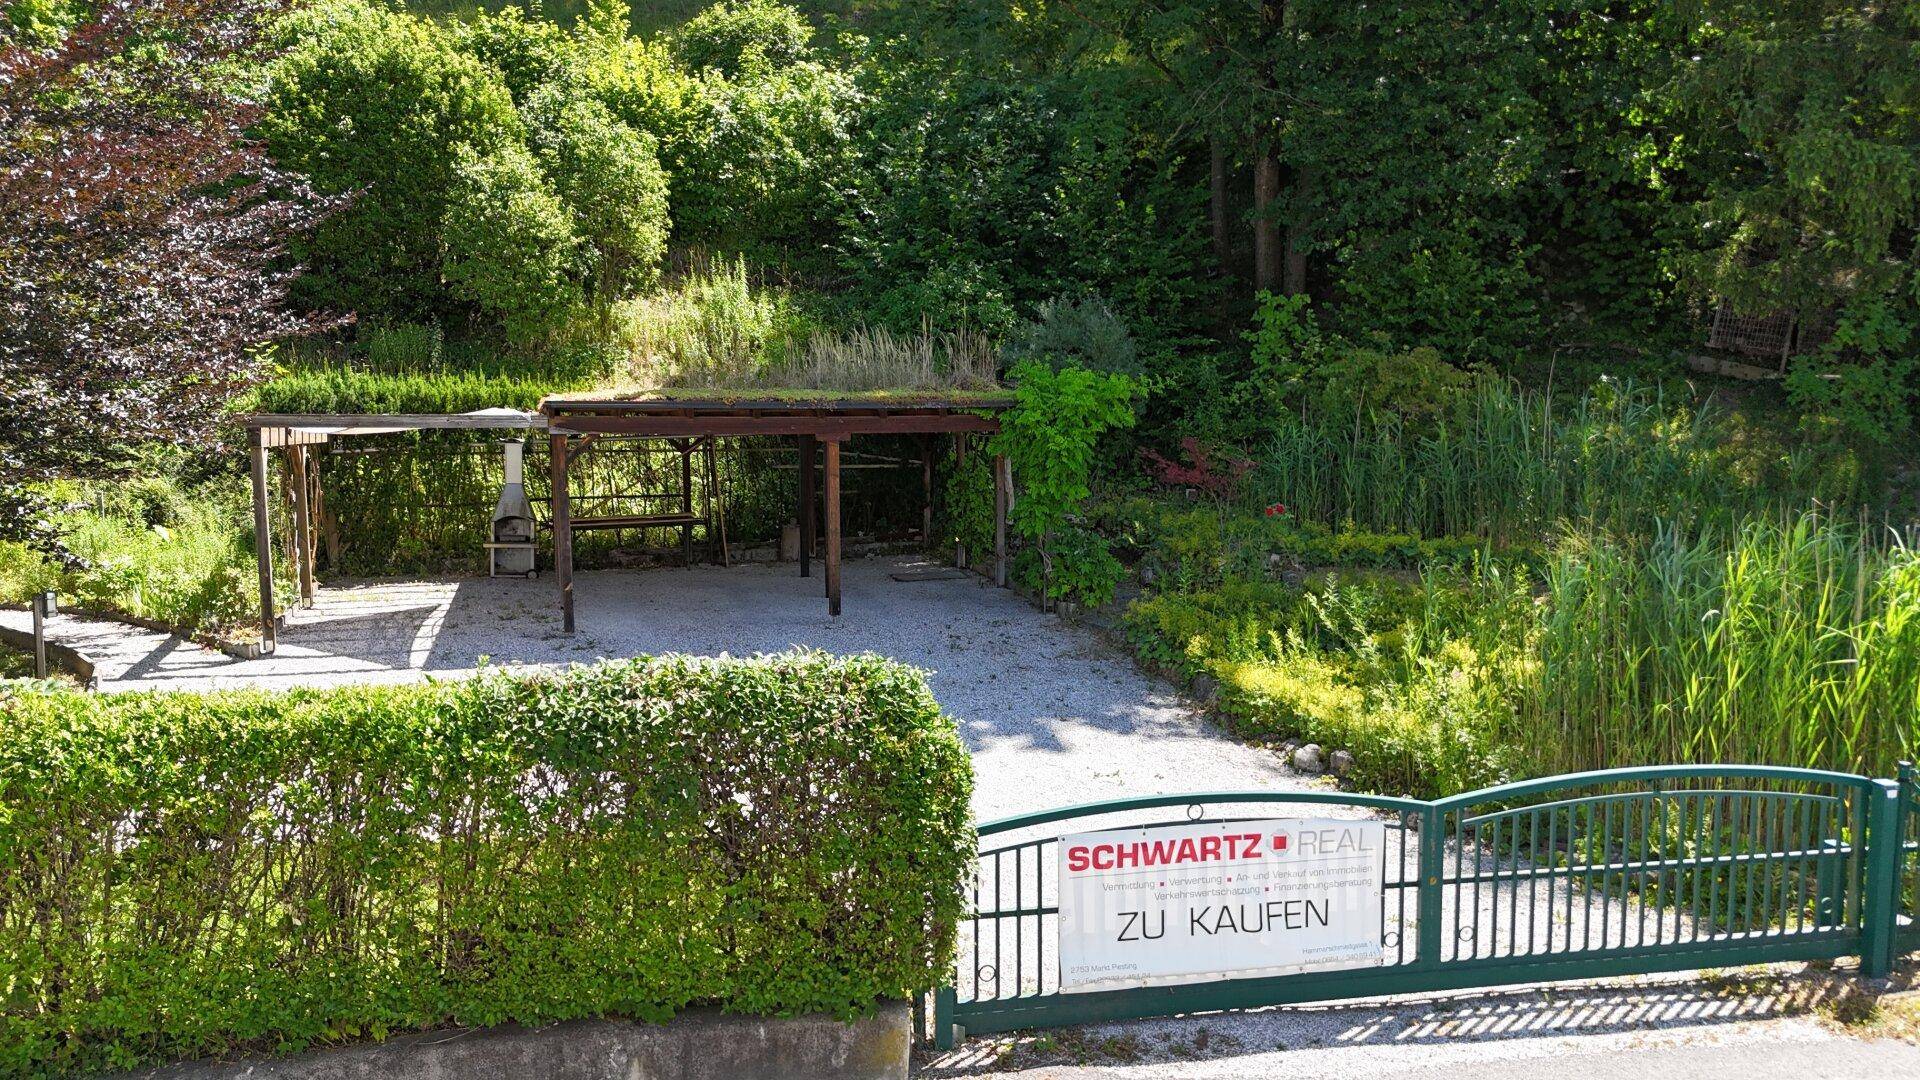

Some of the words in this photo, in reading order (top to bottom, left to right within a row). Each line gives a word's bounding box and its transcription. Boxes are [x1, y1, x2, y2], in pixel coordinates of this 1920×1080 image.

[1068, 833, 1262, 872] SCHWARTZ
[1298, 828, 1373, 856] REAL
[1102, 880, 1155, 891] Vermittlung
[1168, 875, 1222, 886] Verwertung
[1253, 871, 1270, 880] und
[1273, 868, 1307, 879] Verkauf
[1309, 868, 1325, 877] von
[1326, 865, 1373, 875] Immobilien
[1273, 878, 1373, 892] Finanzierungsberatung
[1117, 909, 1165, 942] ZU
[1190, 898, 1329, 936] KAUFEN
